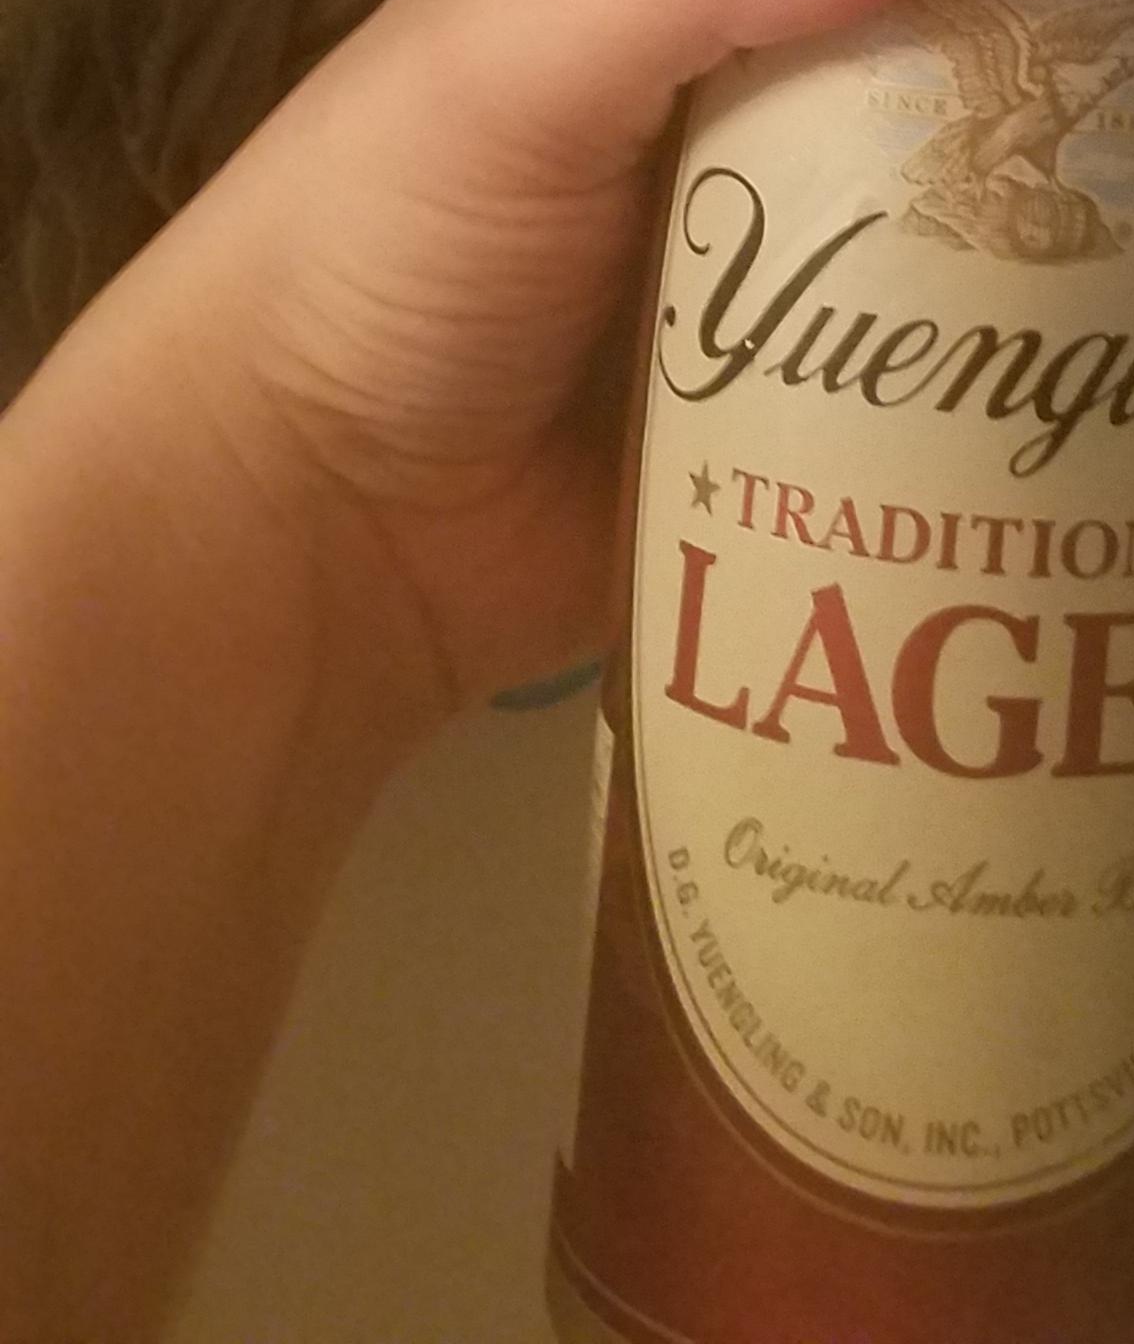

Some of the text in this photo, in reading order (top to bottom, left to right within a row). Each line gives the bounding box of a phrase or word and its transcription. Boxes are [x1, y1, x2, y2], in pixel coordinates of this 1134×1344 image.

[723, 816, 911, 905] Original
[906, 858, 1080, 918] Amber
[690, 916, 806, 1094] YUENGLING
[804, 1078, 832, 1119] &
